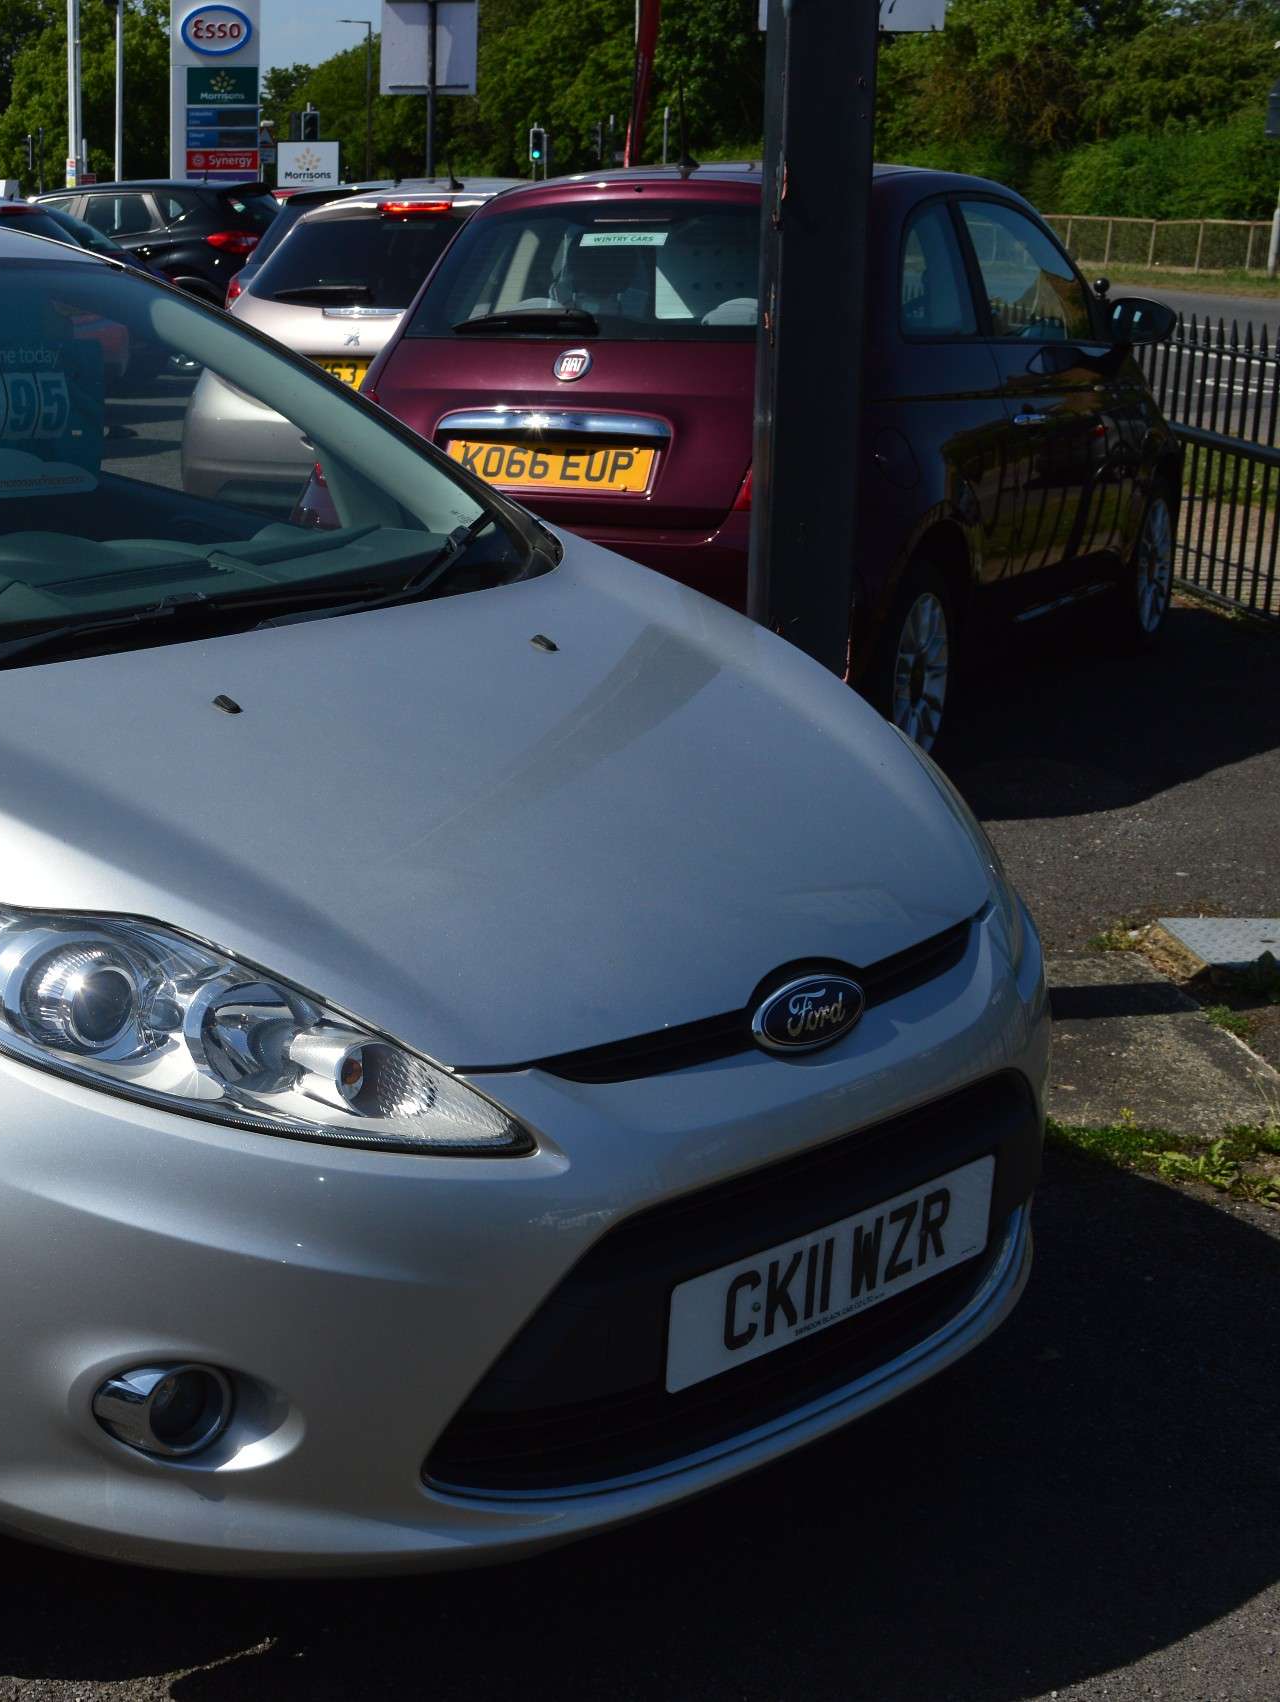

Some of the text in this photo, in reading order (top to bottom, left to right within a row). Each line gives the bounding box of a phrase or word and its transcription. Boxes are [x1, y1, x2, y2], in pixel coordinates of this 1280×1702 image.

[193, 19, 241, 40] Esso
[200, 90, 246, 101] Morrisons
[209, 155, 252, 168] Synergy
[284, 168, 332, 180] Morrisons
[20, 346, 60, 368] today
[560, 357, 585, 373] FIAT
[559, 448, 634, 483] EUP
[787, 988, 846, 1037] Ford
[723, 1237, 835, 1351] CK11
[850, 1188, 951, 1298] WZR
